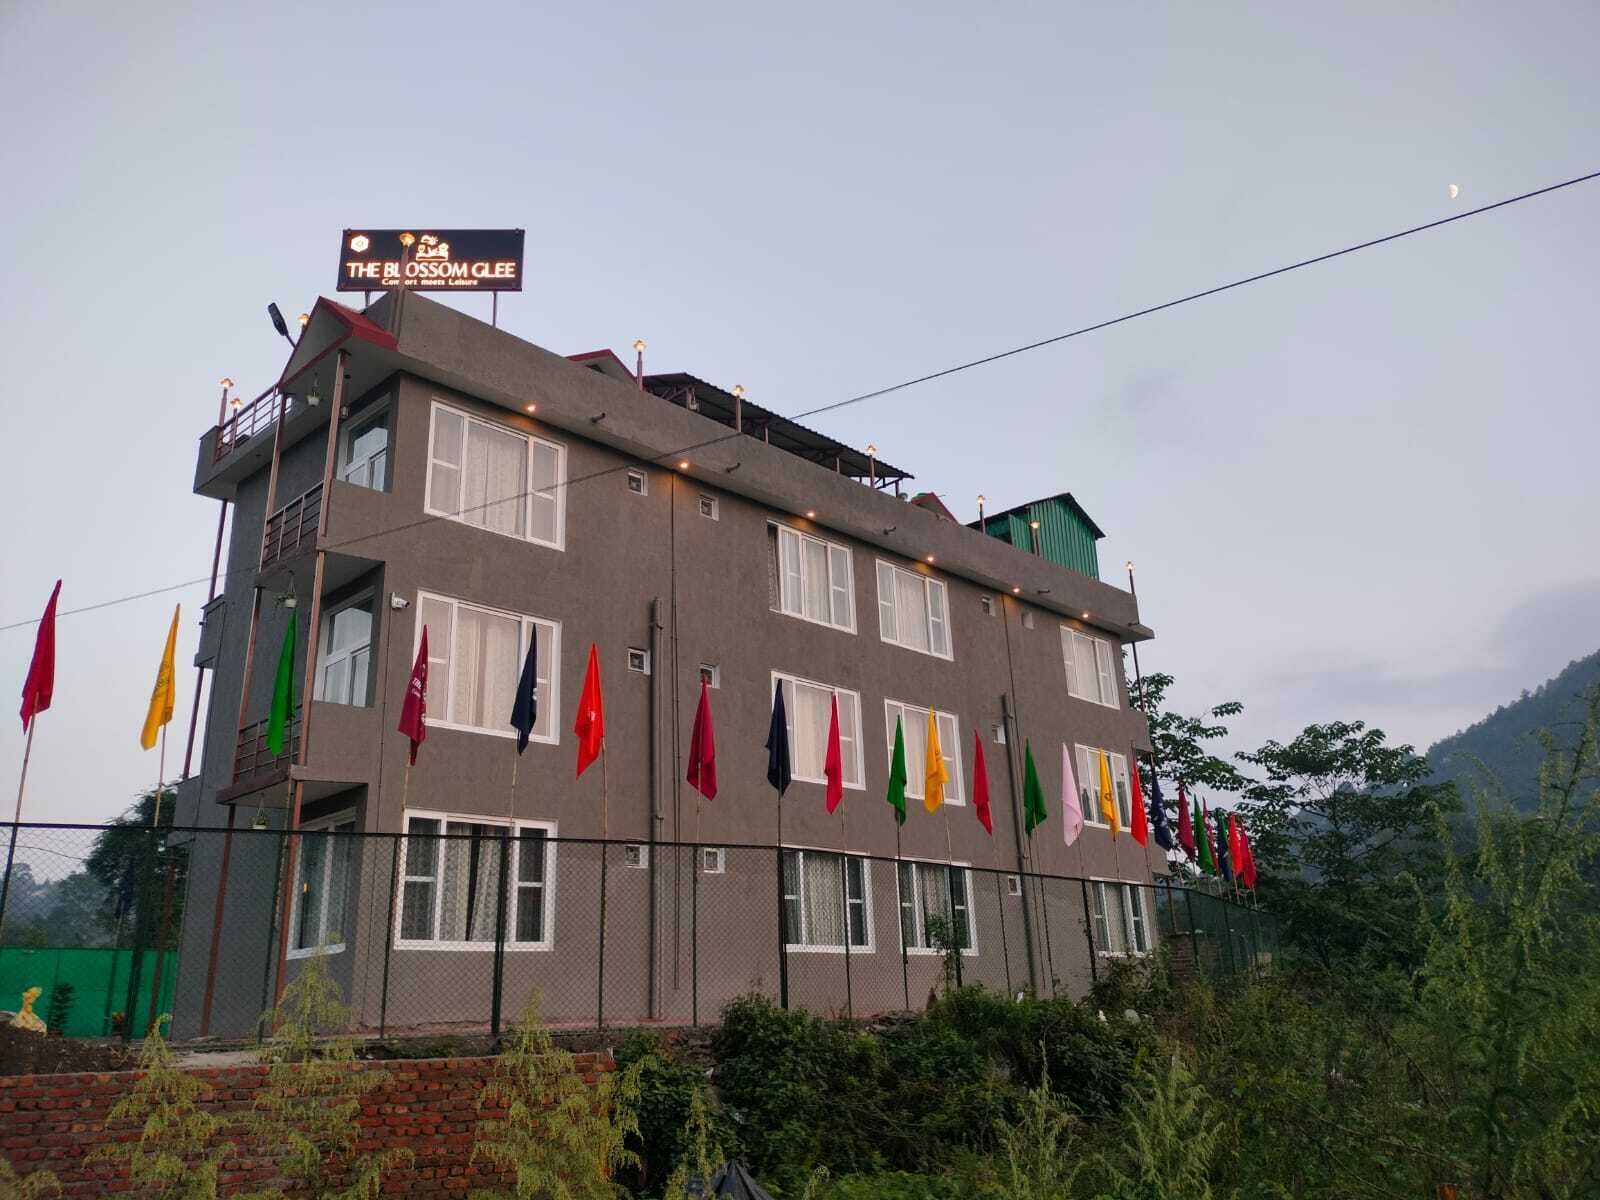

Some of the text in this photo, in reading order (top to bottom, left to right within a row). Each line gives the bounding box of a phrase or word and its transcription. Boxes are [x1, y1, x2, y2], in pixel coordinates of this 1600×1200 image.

[347, 262, 516, 278] THE BLOSSOM GLEE
[382, 278, 418, 286] Comort
[448, 277, 478, 286] Leisure
